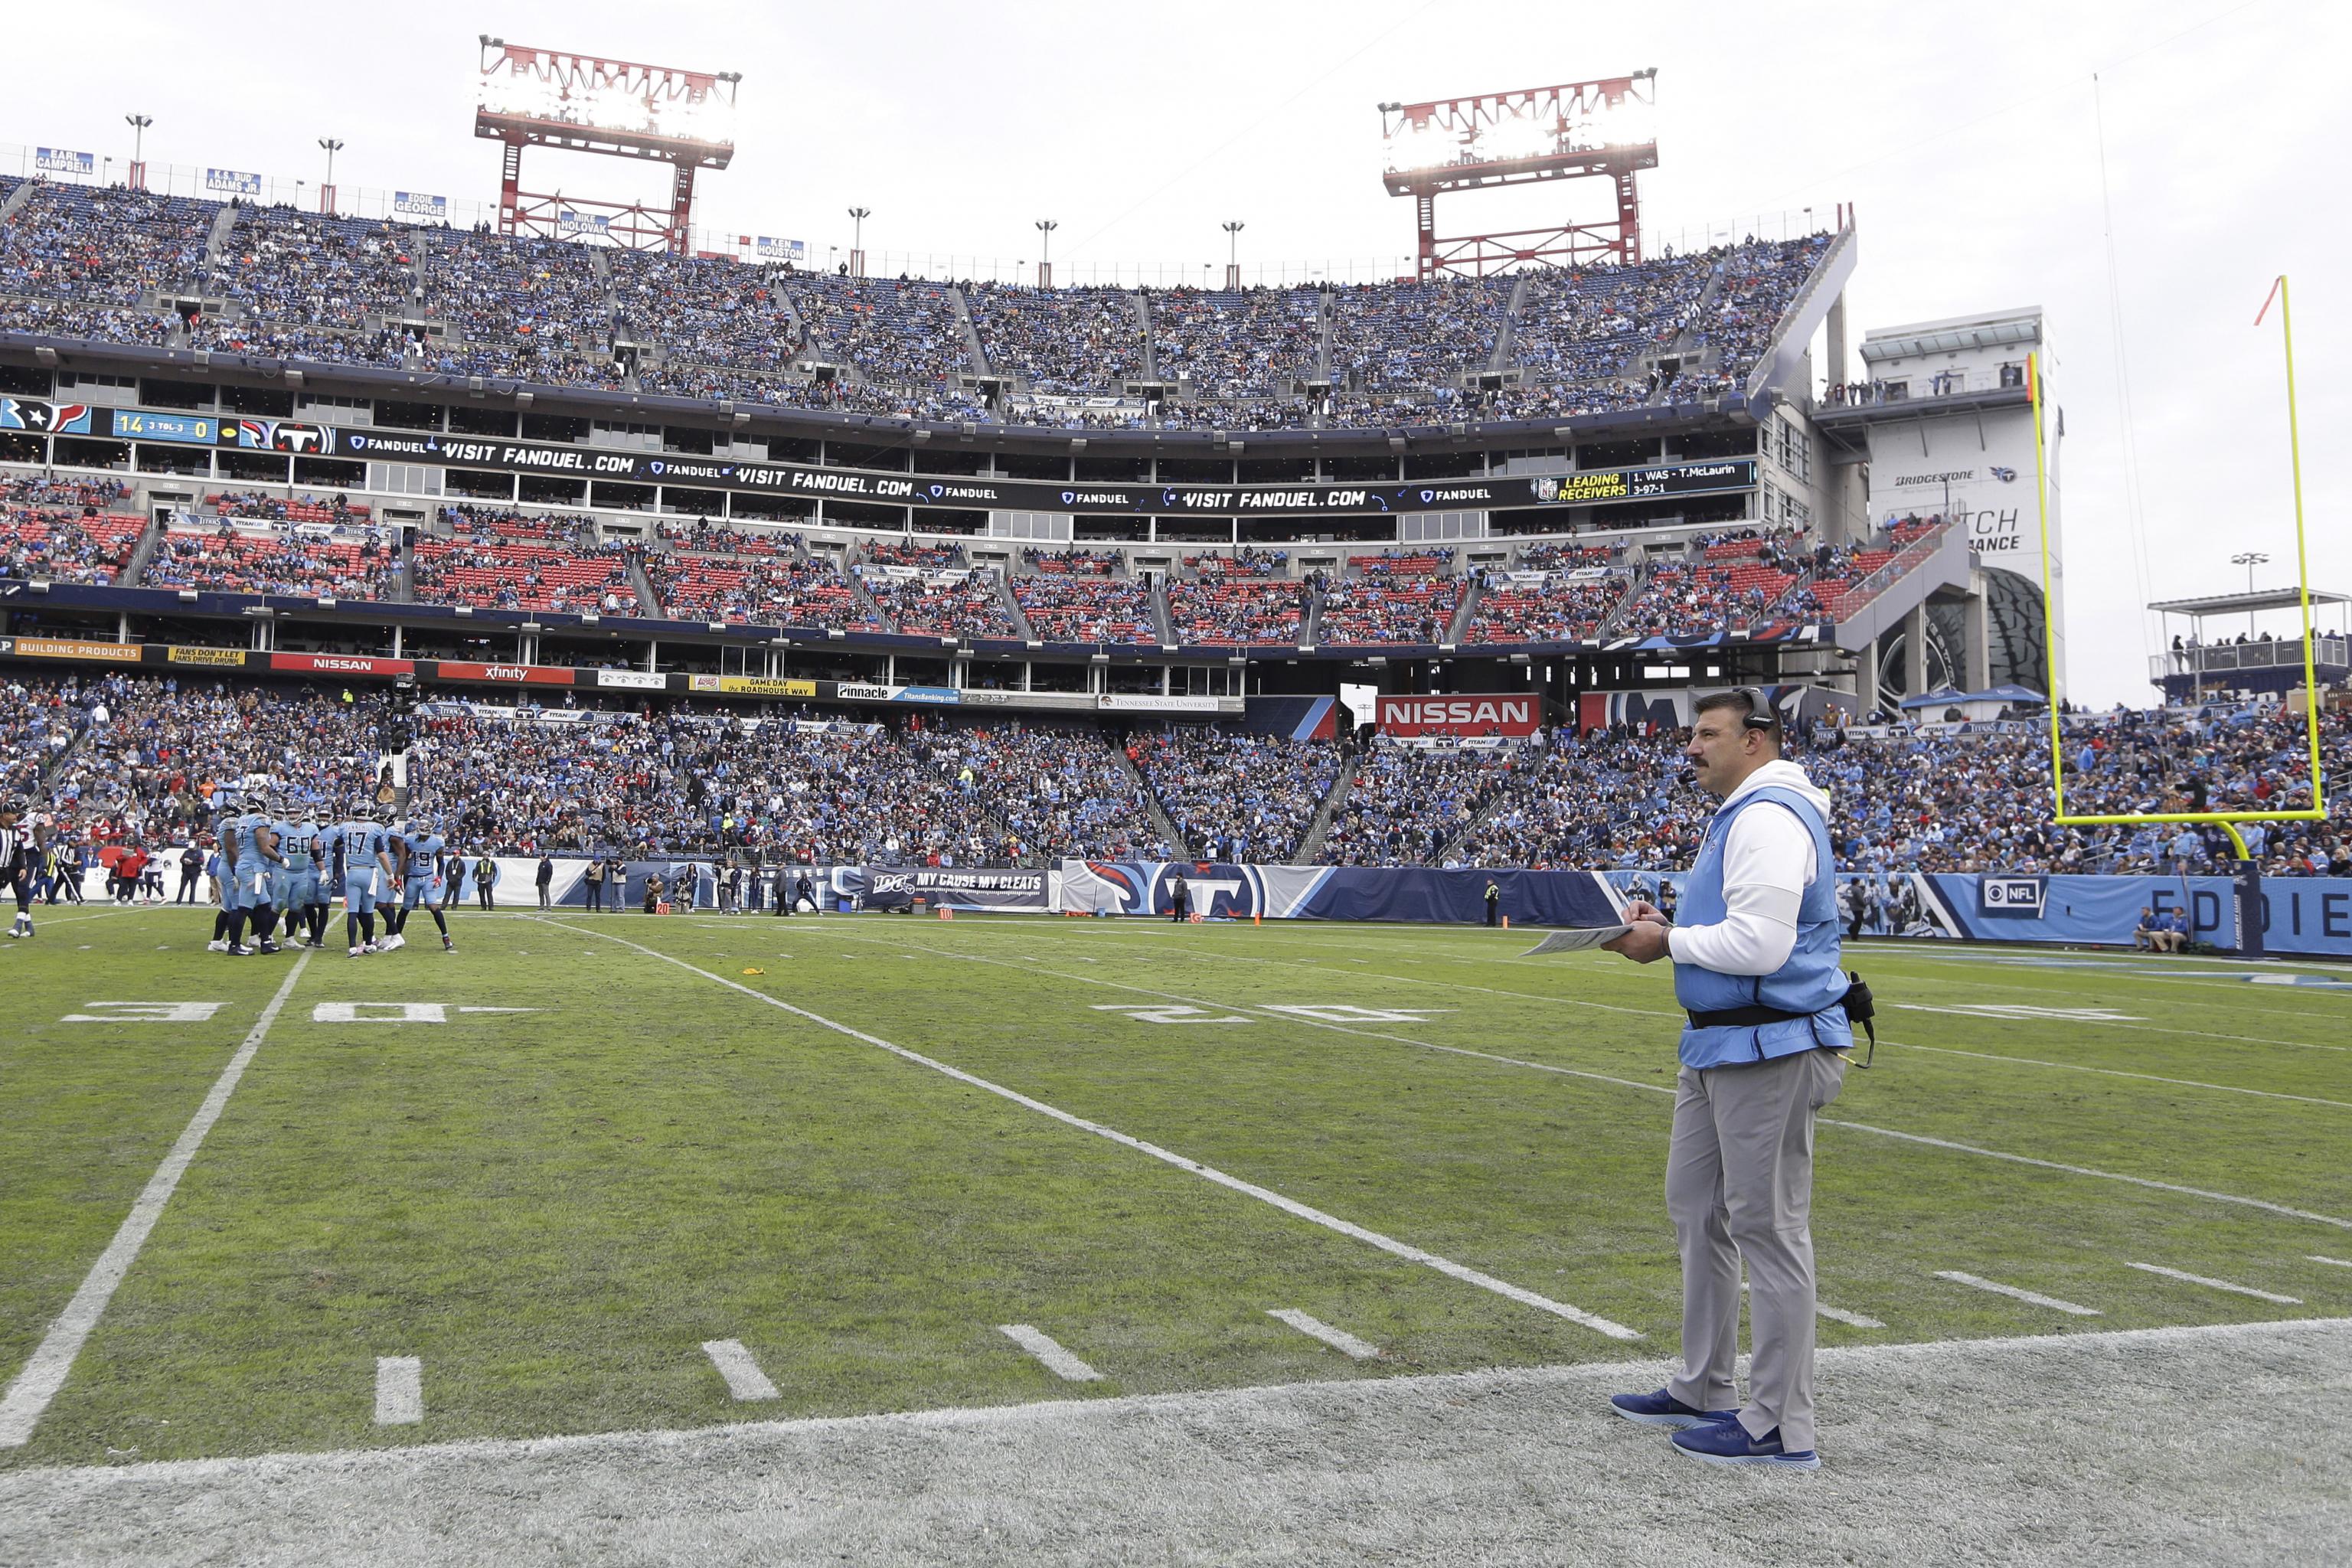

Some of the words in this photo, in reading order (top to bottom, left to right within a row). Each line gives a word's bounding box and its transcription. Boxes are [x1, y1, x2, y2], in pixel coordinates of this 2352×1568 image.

[51, 149, 80, 162] EARL
[37, 157, 92, 174] CAMPBELL
[207, 179, 242, 191] ADAMS
[245, 183, 259, 193] JR.
[408, 194, 433, 205] EDDIE
[396, 202, 445, 217] GEORGE
[574, 213, 596, 223] MIKE
[560, 220, 608, 234] HOLOVAK
[771, 238, 792, 248] KEN
[758, 245, 803, 260] HOUSTON
[119, 416, 142, 433] 14
[194, 422, 207, 438] 0
[368, 439, 426, 453] FANDUEL
[445, 443, 497, 461] VISIT
[503, 448, 634, 472] FANDUEL.COM
[667, 464, 721, 478] FANDUEL
[739, 468, 786, 486] VISIT
[792, 472, 913, 497] FANDUEL.COM
[946, 487, 998, 499] FANDUEL
[1076, 494, 1129, 504] FANDUEL
[1186, 492, 1232, 508] VISIT
[1240, 491, 1366, 508] FANDUEL.COM
[1436, 488, 1491, 501] FANDUEL
[1634, 473, 1642, 482] 1.
[1645, 470, 1669, 482] WAS
[1679, 464, 1735, 479] T.McLaurin
[1895, 470, 1974, 486] BRIDGESTONE
[1566, 473, 1619, 488] LEADING
[1558, 484, 1627, 501] RECEIVERS
[1634, 485, 1665, 495] 3-97-1
[21, 643, 74, 654] BUILDING
[78, 645, 137, 657] PRODUCTS
[313, 658, 372, 671] NISSAN
[485, 667, 528, 681] xfinity
[728, 684, 739, 692] the
[740, 685, 789, 695] ROADHOUSE
[750, 678, 769, 688] GAME
[771, 679, 788, 688] DAY
[840, 683, 888, 699] Pinnacle
[904, 692, 959, 703] TitansBanking.com
[1115, 698, 1154, 707] TENNESSEE
[1176, 700, 1217, 708] UNIVERSITY
[1385, 702, 1529, 724] NISSAN
[286, 835, 310, 855] 60
[347, 831, 368, 855] 17
[413, 850, 431, 867] 19
[916, 872, 937, 885] MY
[939, 874, 976, 888] CAUSE
[978, 875, 998, 889] MY
[999, 876, 1042, 890] CLEATS
[2009, 887, 2034, 900] NFL
[657, 904, 669, 914] 20
[941, 909, 952, 919] 10
[1192, 913, 1201, 923] G
